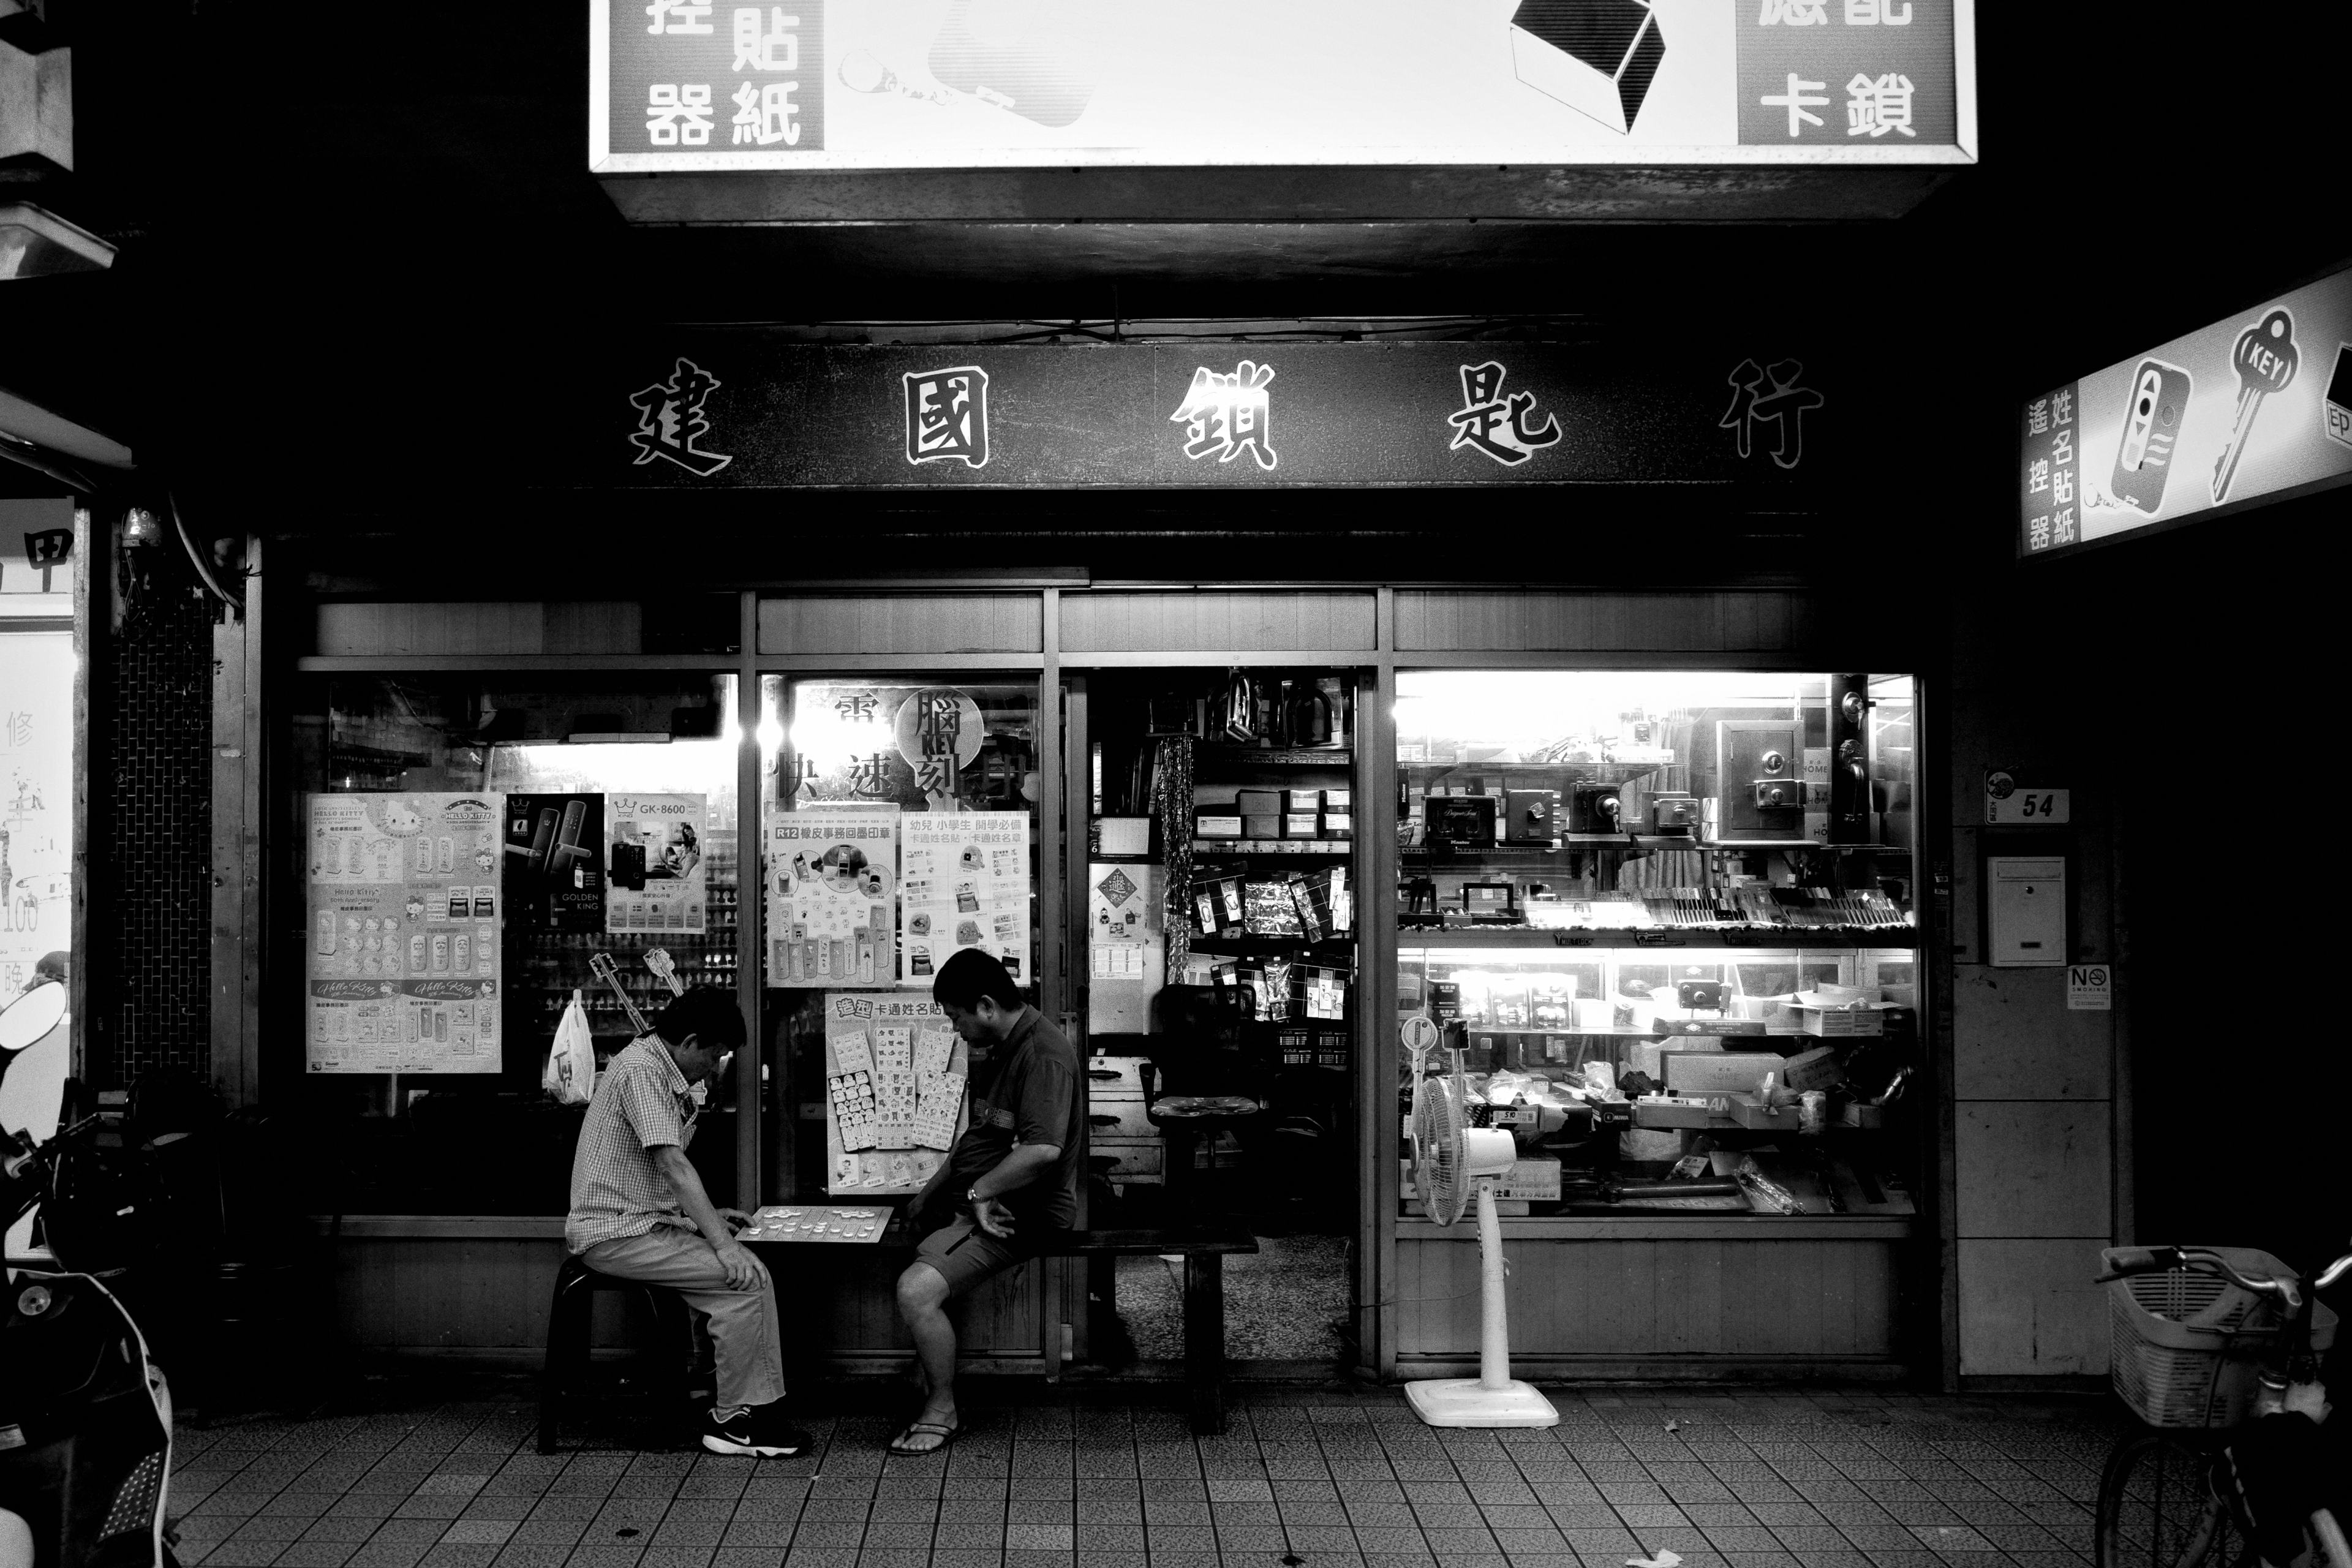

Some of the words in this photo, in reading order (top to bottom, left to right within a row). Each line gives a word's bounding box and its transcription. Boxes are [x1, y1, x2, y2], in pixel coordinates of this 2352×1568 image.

[2248, 341, 2285, 381] KEY
[628, 356, 1826, 473] 建國鎖匙行
[2051, 388, 2075, 545] 姓名貼紙
[921, 734, 958, 756] KEY
[773, 752, 1028, 800] 快速刻印
[639, 804, 686, 815] GK-8600
[2022, 794, 2054, 817] 54
[909, 820, 932, 831] 幼兒
[936, 819, 971, 831] 小學生
[975, 819, 1022, 831] 開學必備
[777, 829, 797, 838] R12
[800, 827, 891, 840] 橡皮事務回墨印章
[356, 888, 375, 897] Kitty
[562, 893, 599, 902] GOLDEN
[576, 902, 599, 911] KING
[317, 982, 348, 995] Hello
[349, 981, 377, 997] Kitty
[415, 981, 446, 995] Hello
[447, 981, 476, 996] Kitty
